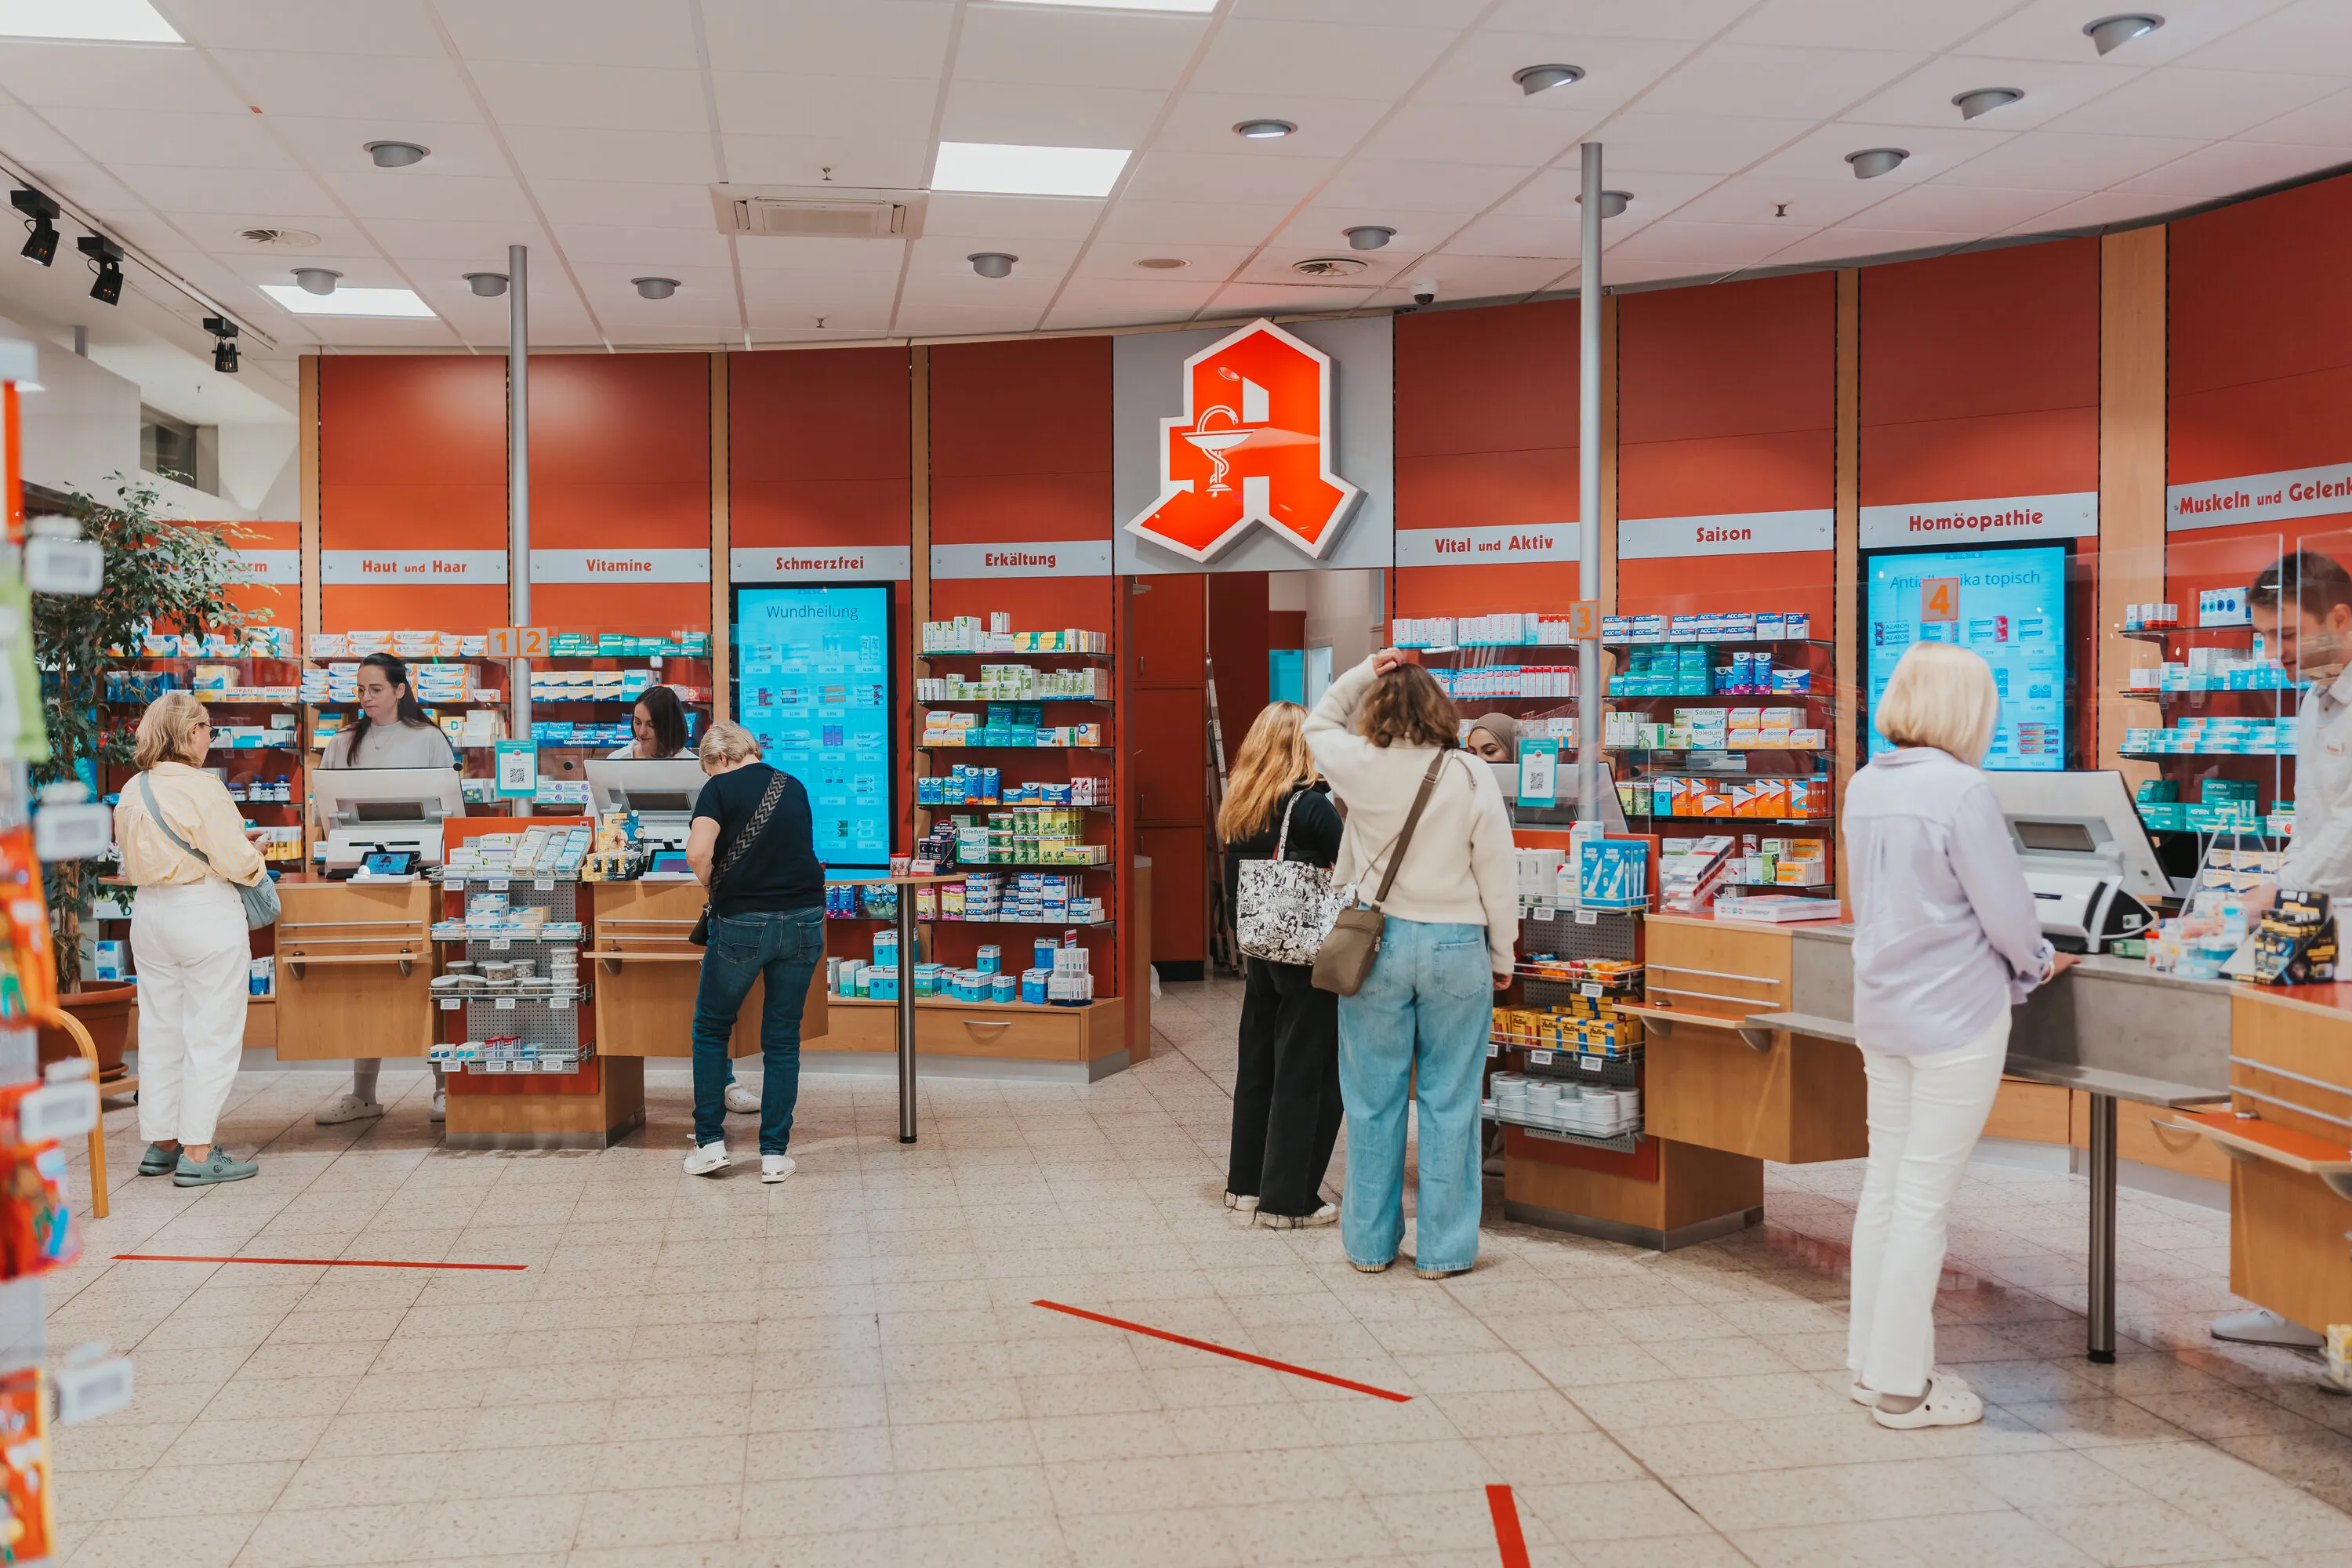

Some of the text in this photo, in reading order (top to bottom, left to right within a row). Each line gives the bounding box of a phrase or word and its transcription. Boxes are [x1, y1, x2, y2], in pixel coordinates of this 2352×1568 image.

[2180, 491, 2250, 514] Muskeln
[2257, 490, 2281, 506] und
[1909, 509, 2043, 532] Homöopathie
[1696, 527, 1751, 542] Saison
[1434, 535, 1553, 553] Vital und Aktiv
[362, 560, 466, 572] Haut und Haar
[586, 559, 652, 572] Vitamine
[776, 555, 864, 571] Schmerzfrei
[985, 552, 1056, 568] Erkältung
[1890, 571, 2040, 589] Antiika topisch
[1929, 584, 1951, 615] 4
[766, 605, 858, 621] Wundheilung
[1577, 606, 1591, 633] 3
[495, 631, 507, 652] 1
[526, 631, 541, 652] 2
